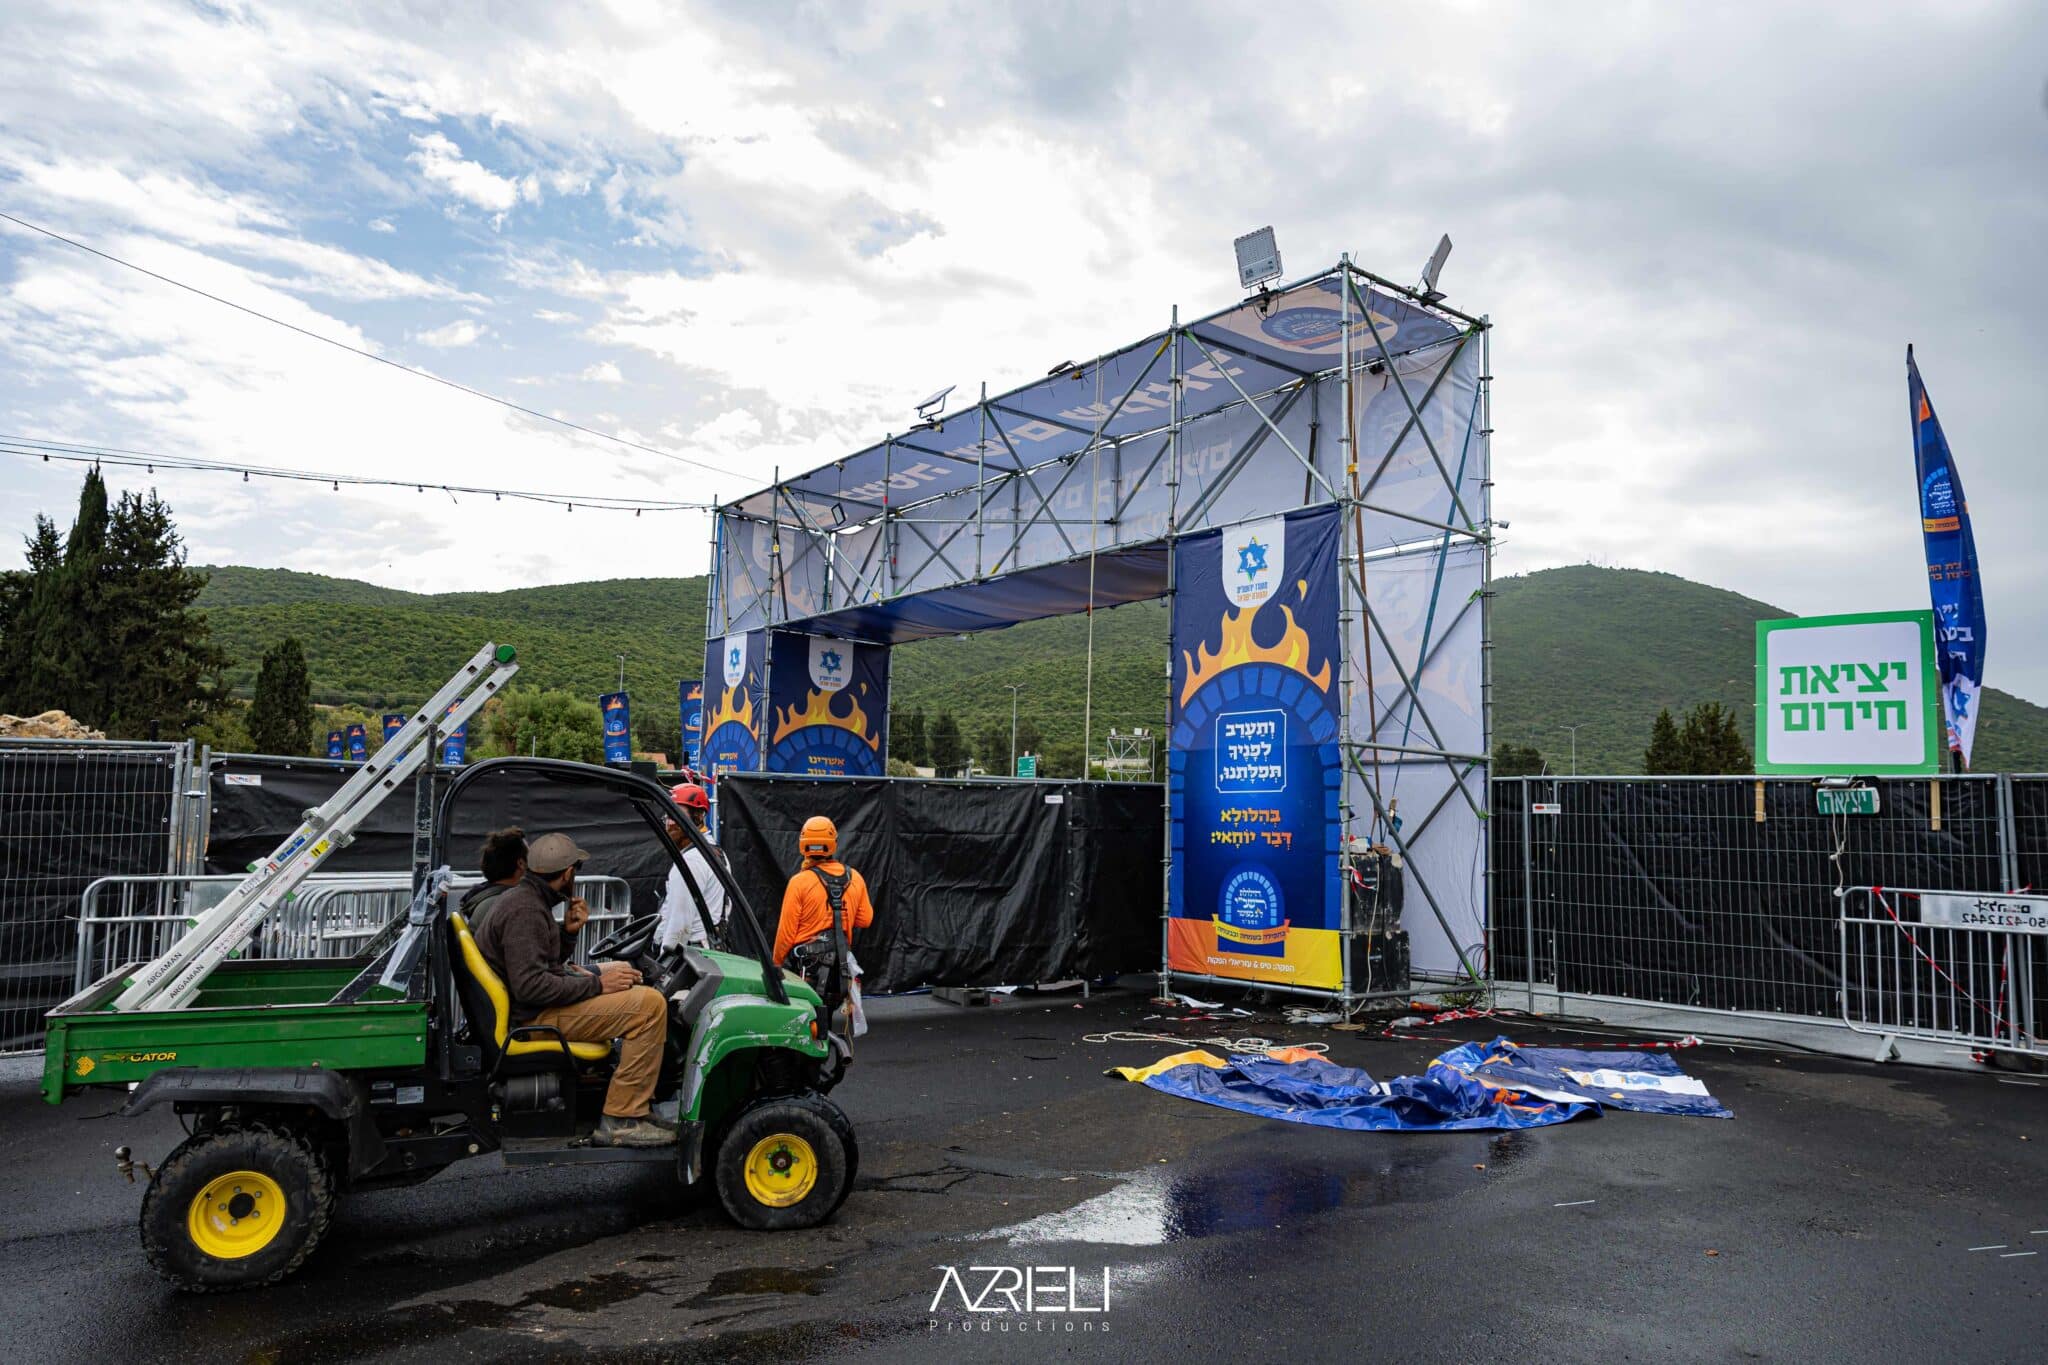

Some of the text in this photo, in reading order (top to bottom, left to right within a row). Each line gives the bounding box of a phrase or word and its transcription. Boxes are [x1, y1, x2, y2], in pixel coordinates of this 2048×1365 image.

[1780, 662, 1907, 695] יציאת
[1780, 701, 1907, 731] חירום
[1823, 791, 1867, 813] יציאה
[146, 952, 183, 986] ARGAMAN
[170, 964, 205, 999] ARGAMAN
[130, 1052, 177, 1062] GATOR
